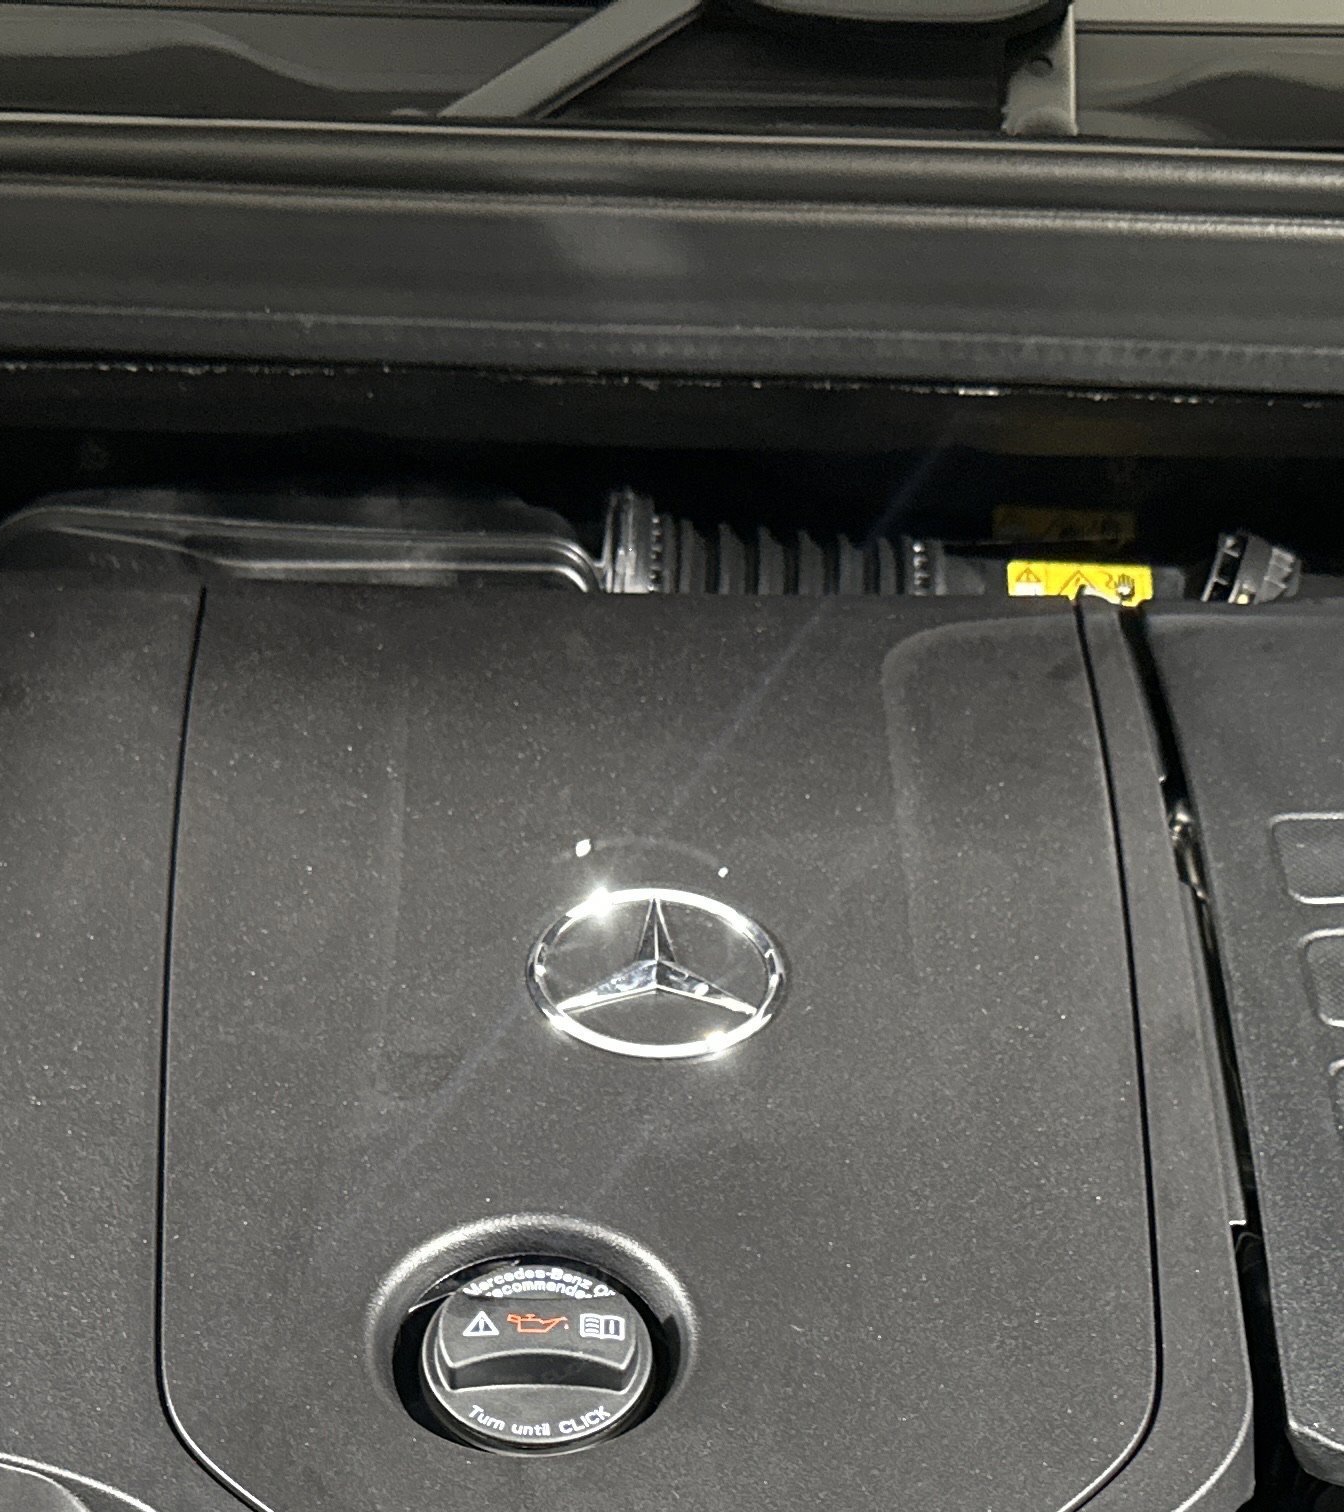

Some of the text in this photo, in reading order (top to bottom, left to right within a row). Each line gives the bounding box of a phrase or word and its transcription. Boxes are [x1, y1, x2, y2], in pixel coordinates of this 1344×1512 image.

[463, 1267, 593, 1296] Mercedes-Benz
[485, 1280, 593, 1299] ecommende
[468, 1404, 611, 1436] Turn until CLICK
